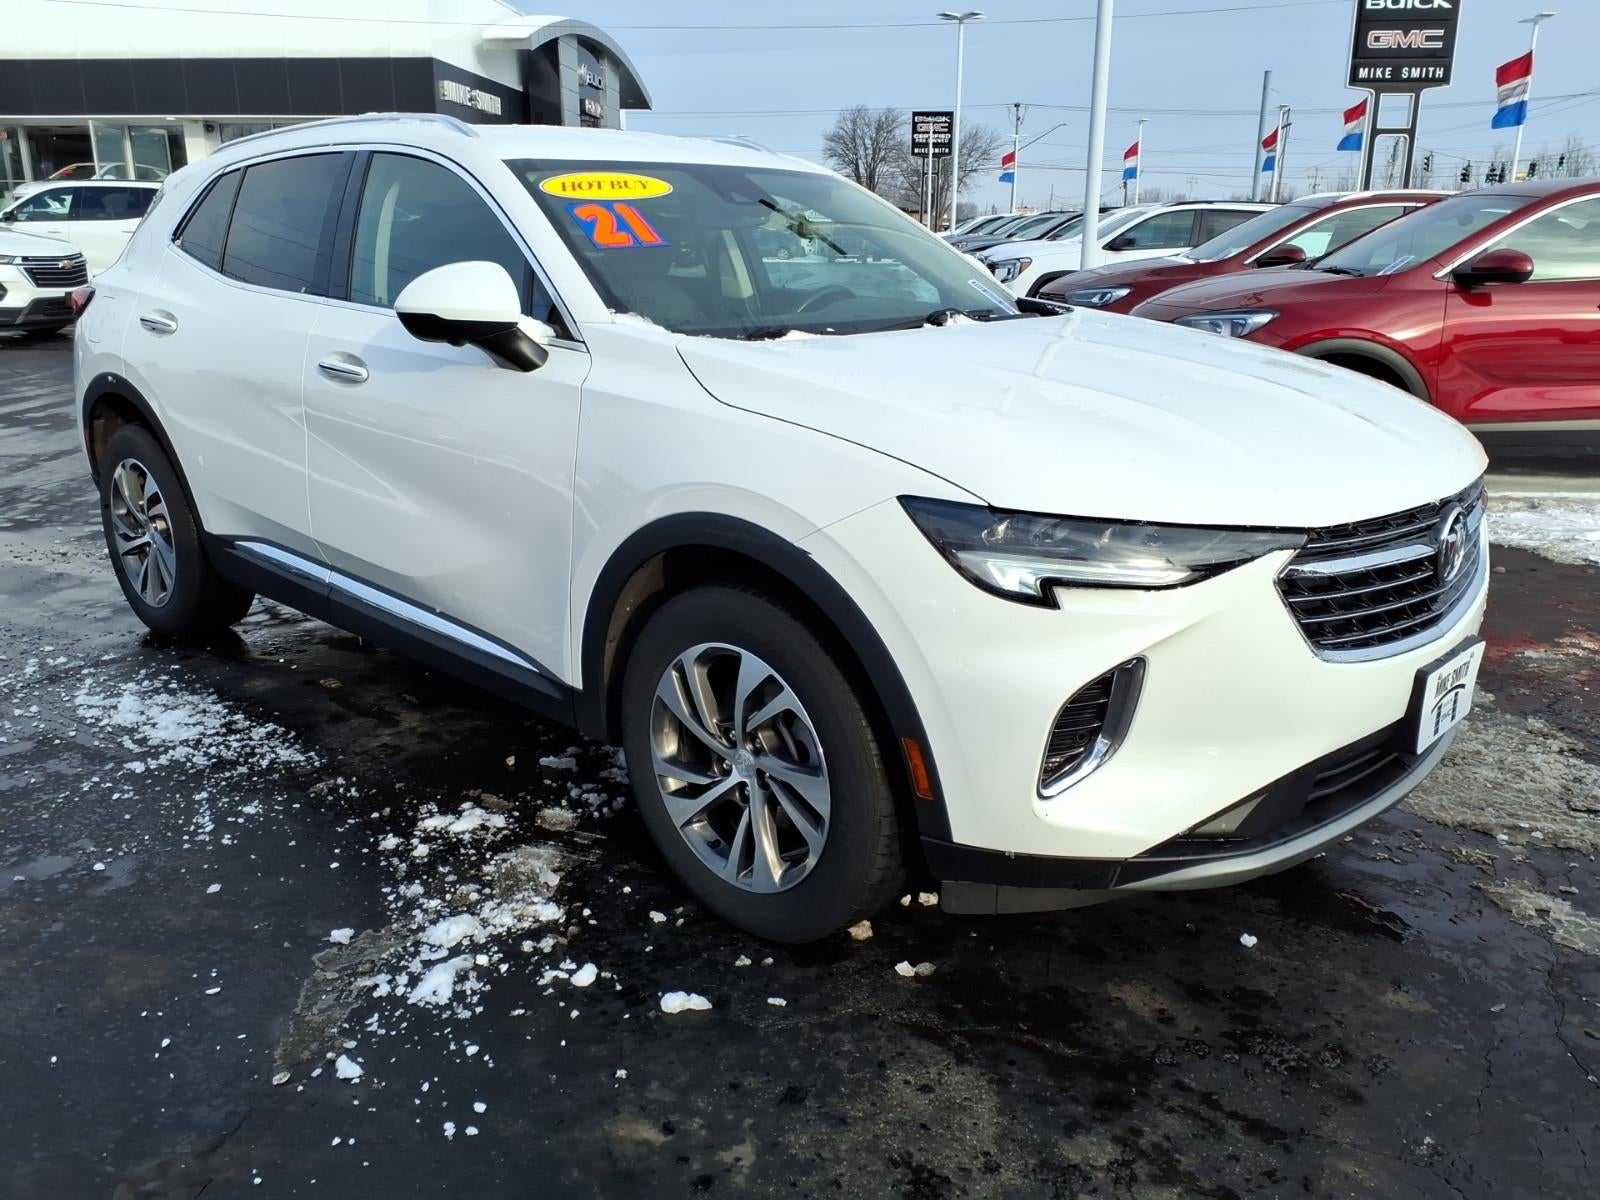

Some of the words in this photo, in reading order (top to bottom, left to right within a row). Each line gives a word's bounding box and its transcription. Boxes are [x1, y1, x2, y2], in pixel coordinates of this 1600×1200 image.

[1366, 0, 1452, 9] BUICK
[1367, 29, 1445, 48] GMC
[1359, 67, 1393, 78] MIKE
[1401, 67, 1444, 78] SMITH
[442, 80, 471, 107] MIKE
[472, 90, 502, 116] SMITH
[561, 180, 606, 192] HOT
[610, 180, 649, 190] BUY
[574, 202, 664, 247] 21
[1434, 672, 1451, 699] MIKE
[1450, 660, 1471, 688] SMITH
